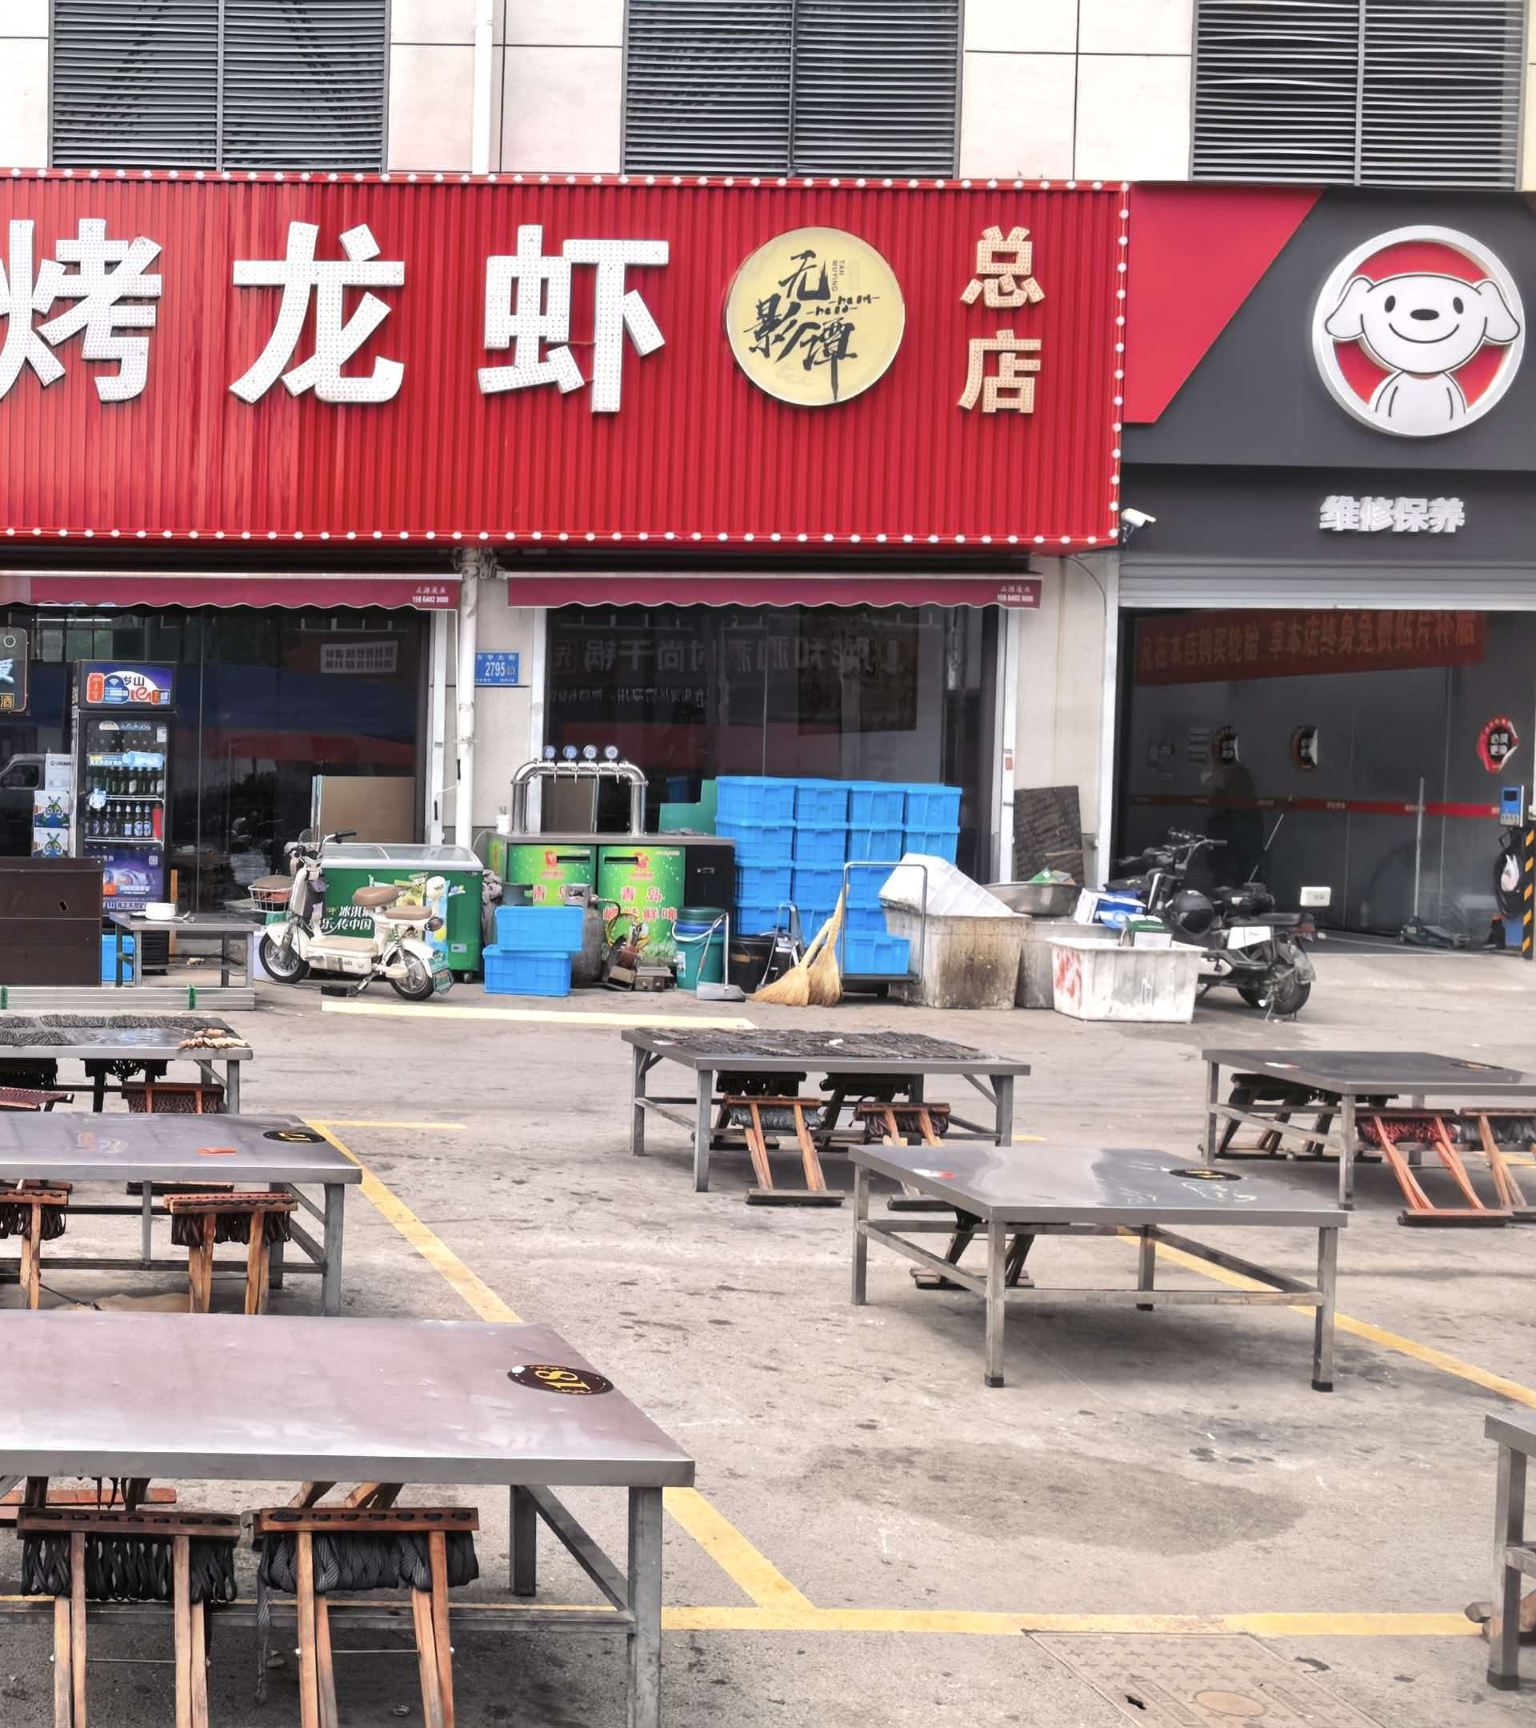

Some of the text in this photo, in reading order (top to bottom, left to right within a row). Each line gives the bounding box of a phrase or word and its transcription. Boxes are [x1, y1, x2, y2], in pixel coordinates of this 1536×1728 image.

[742, 248, 859, 402] 无影潭
[956, 224, 1046, 415] 总店
[1319, 495, 1466, 533] 维修保养
[485, 661, 506, 677] 2795
[534, 1369, 591, 1390] 18
